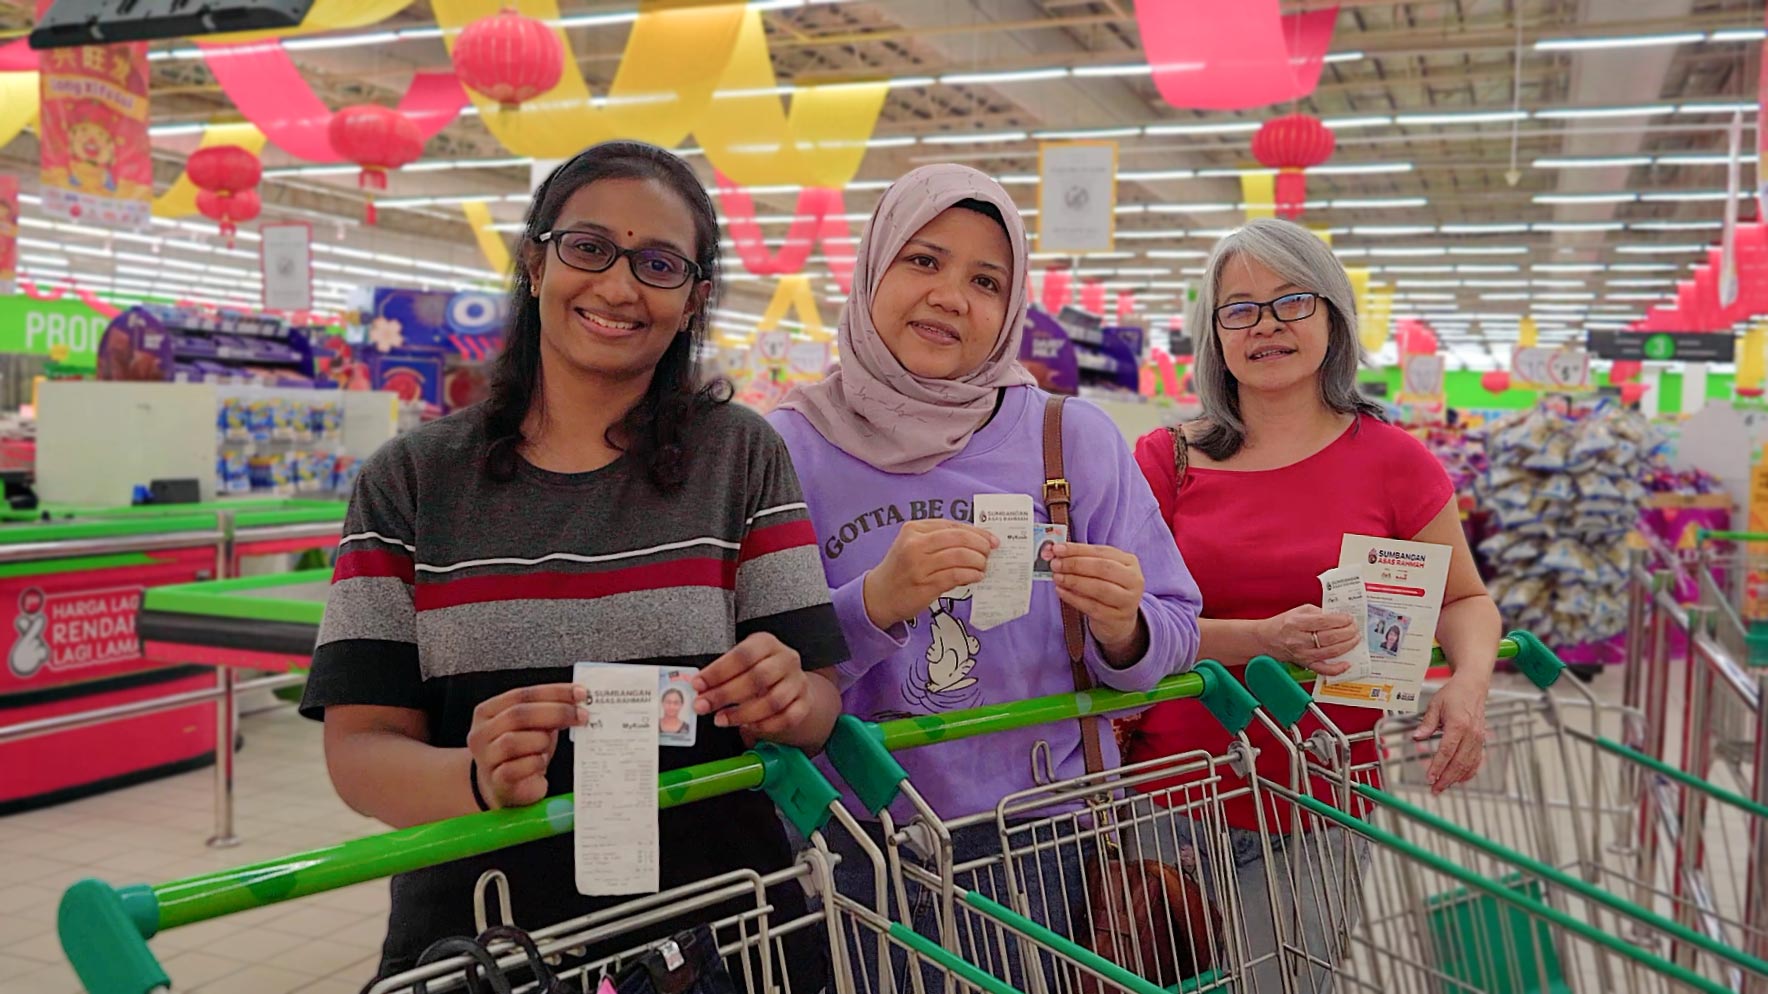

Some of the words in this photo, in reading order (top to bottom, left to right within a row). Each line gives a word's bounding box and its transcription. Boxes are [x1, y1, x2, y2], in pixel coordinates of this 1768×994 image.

[825, 504, 904, 560] GOTTA
[909, 499, 944, 521] BE
[950, 499, 975, 524] G
[1378, 549, 1426, 561] SUMBANGAN
[53, 599, 107, 619] HARGA
[111, 594, 139, 613] LAG
[54, 643, 93, 665] LAGI
[594, 689, 652, 698] SUMBANGAN
